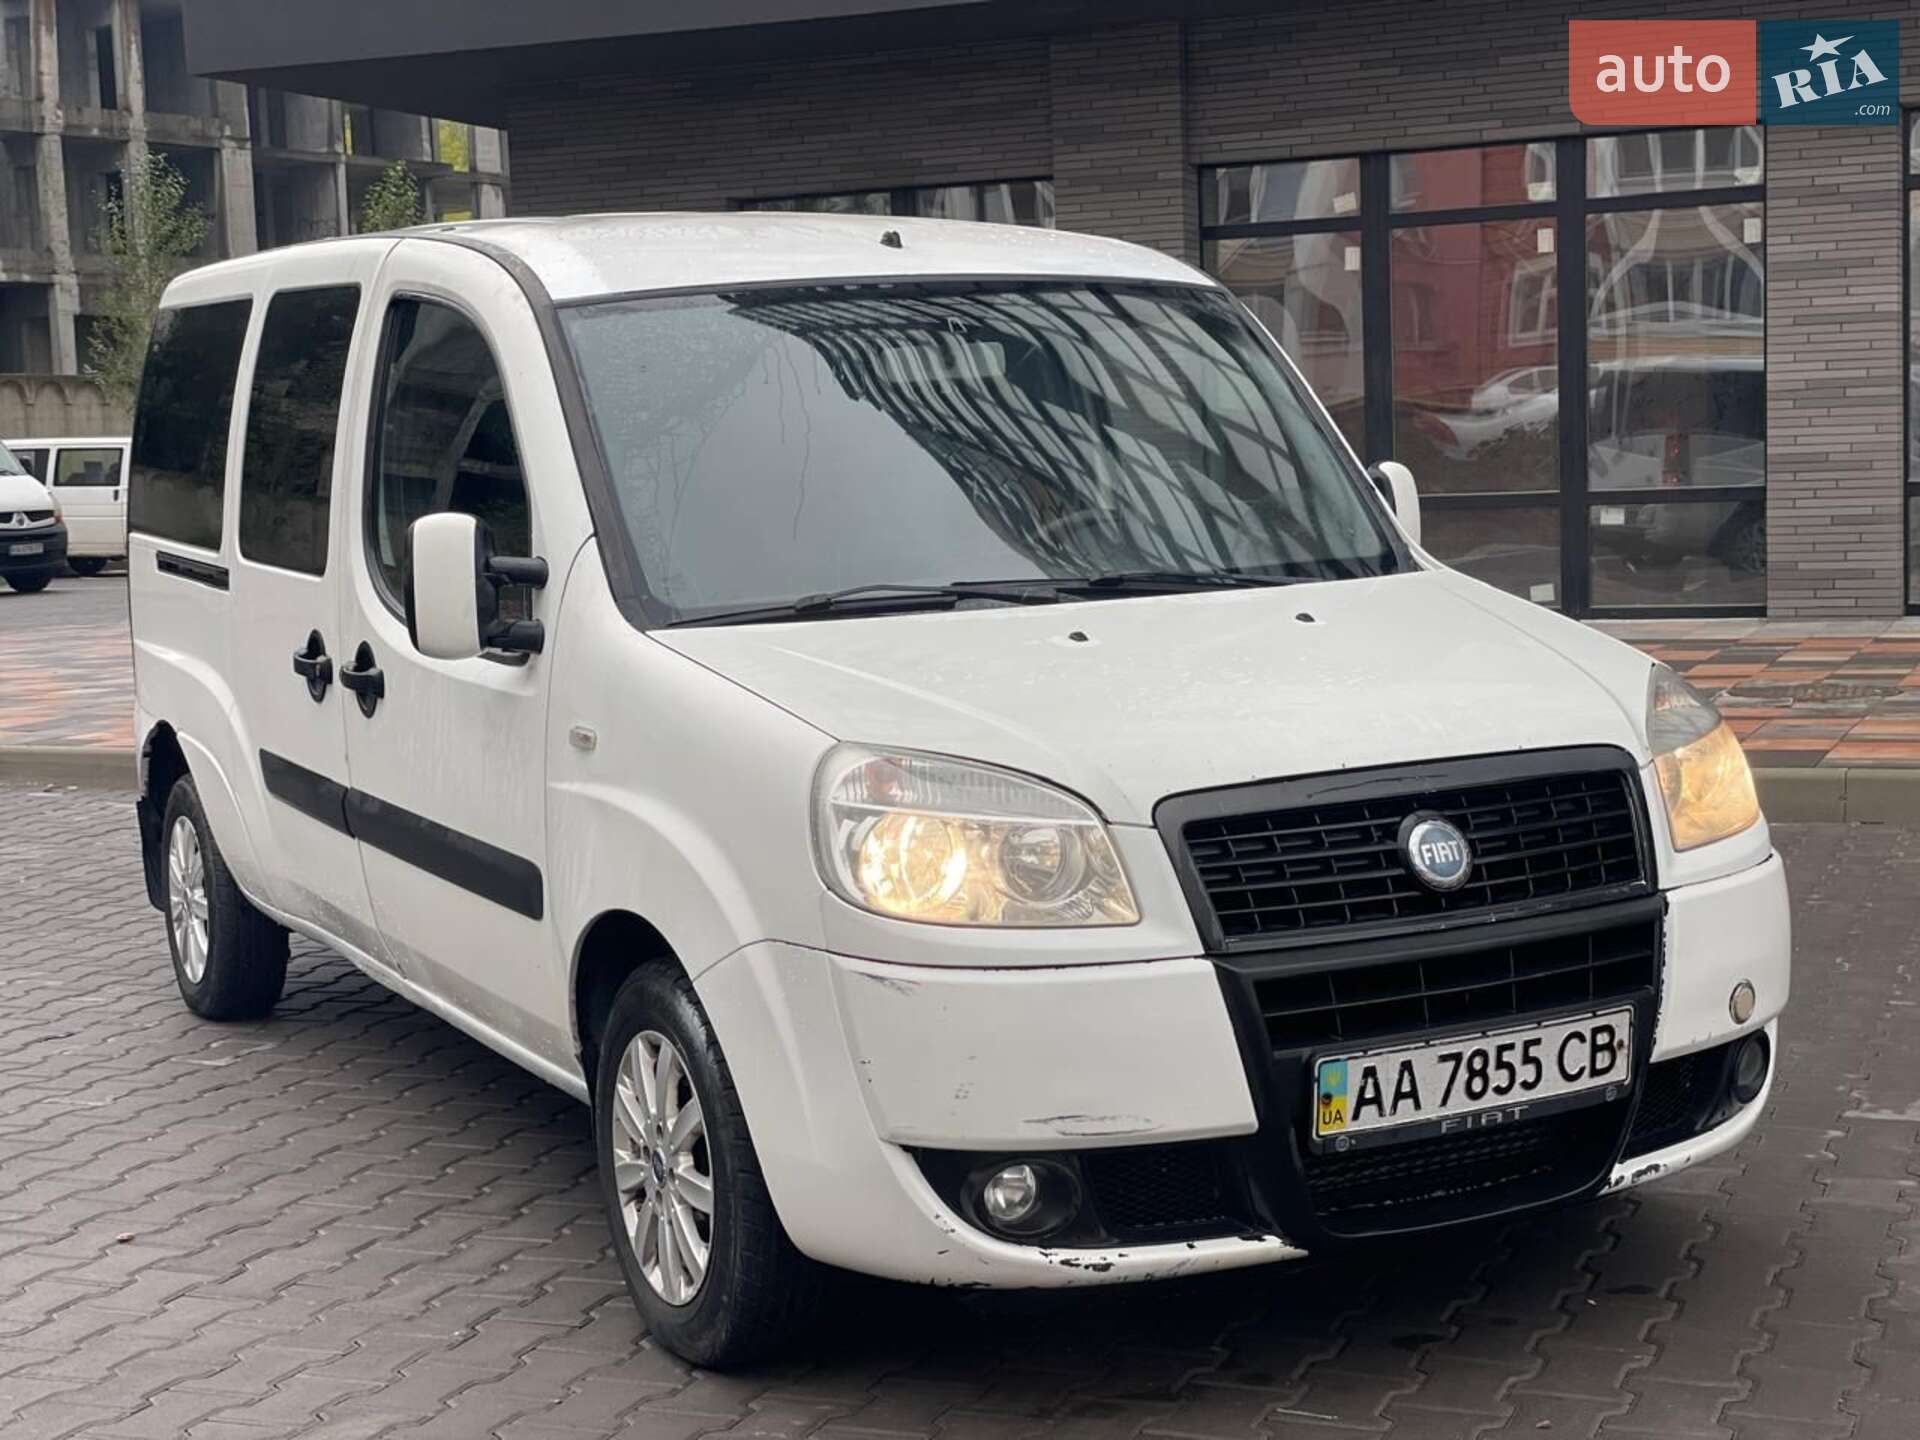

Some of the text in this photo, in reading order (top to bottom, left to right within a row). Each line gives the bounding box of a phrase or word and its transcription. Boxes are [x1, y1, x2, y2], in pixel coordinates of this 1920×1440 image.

[1420, 840, 1460, 865] FIAT
[1351, 1023, 1617, 1121] AA 7855 CB
[1321, 1110, 1345, 1126] UA
[1441, 1105, 1529, 1134] FIAT
